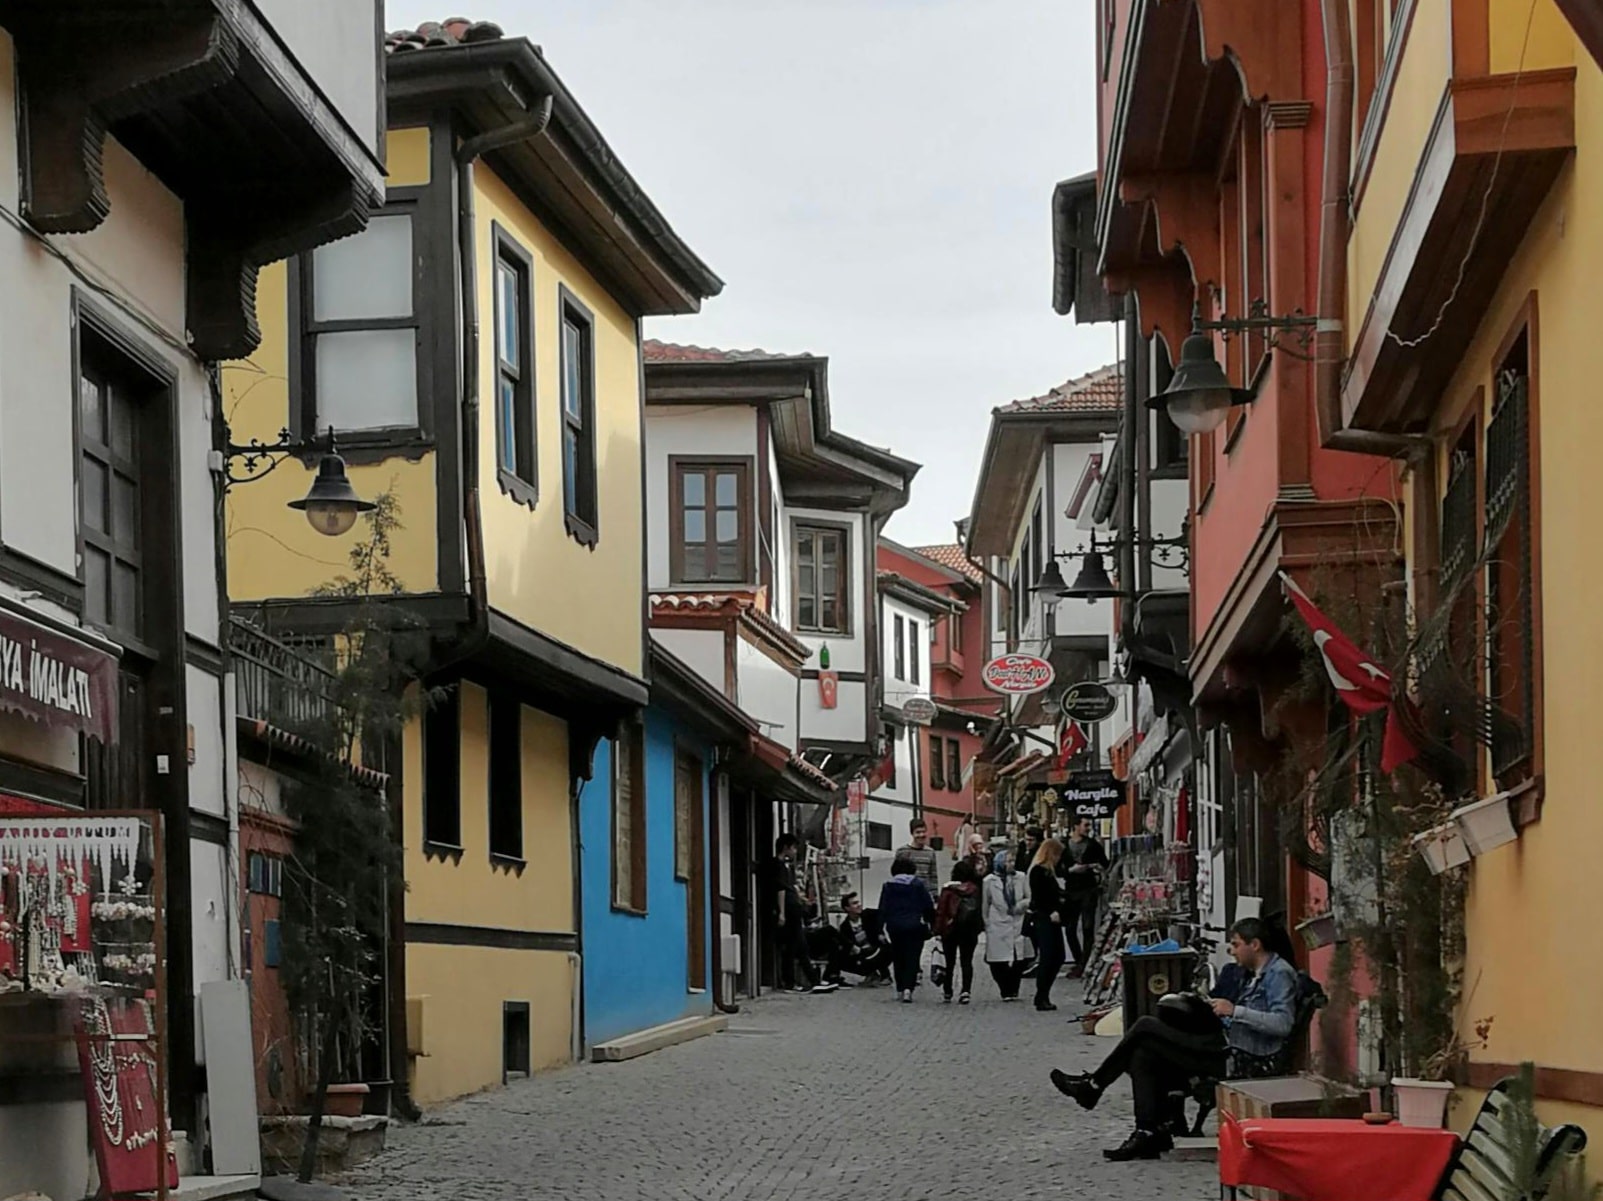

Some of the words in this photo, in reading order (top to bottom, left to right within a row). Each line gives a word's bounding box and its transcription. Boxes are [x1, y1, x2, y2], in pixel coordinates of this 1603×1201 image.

[0, 634, 24, 693] YA
[30, 639, 92, 718] İMALATI
[1064, 787, 1119, 801] Nargile
[1076, 803, 1108, 817] Cafe
